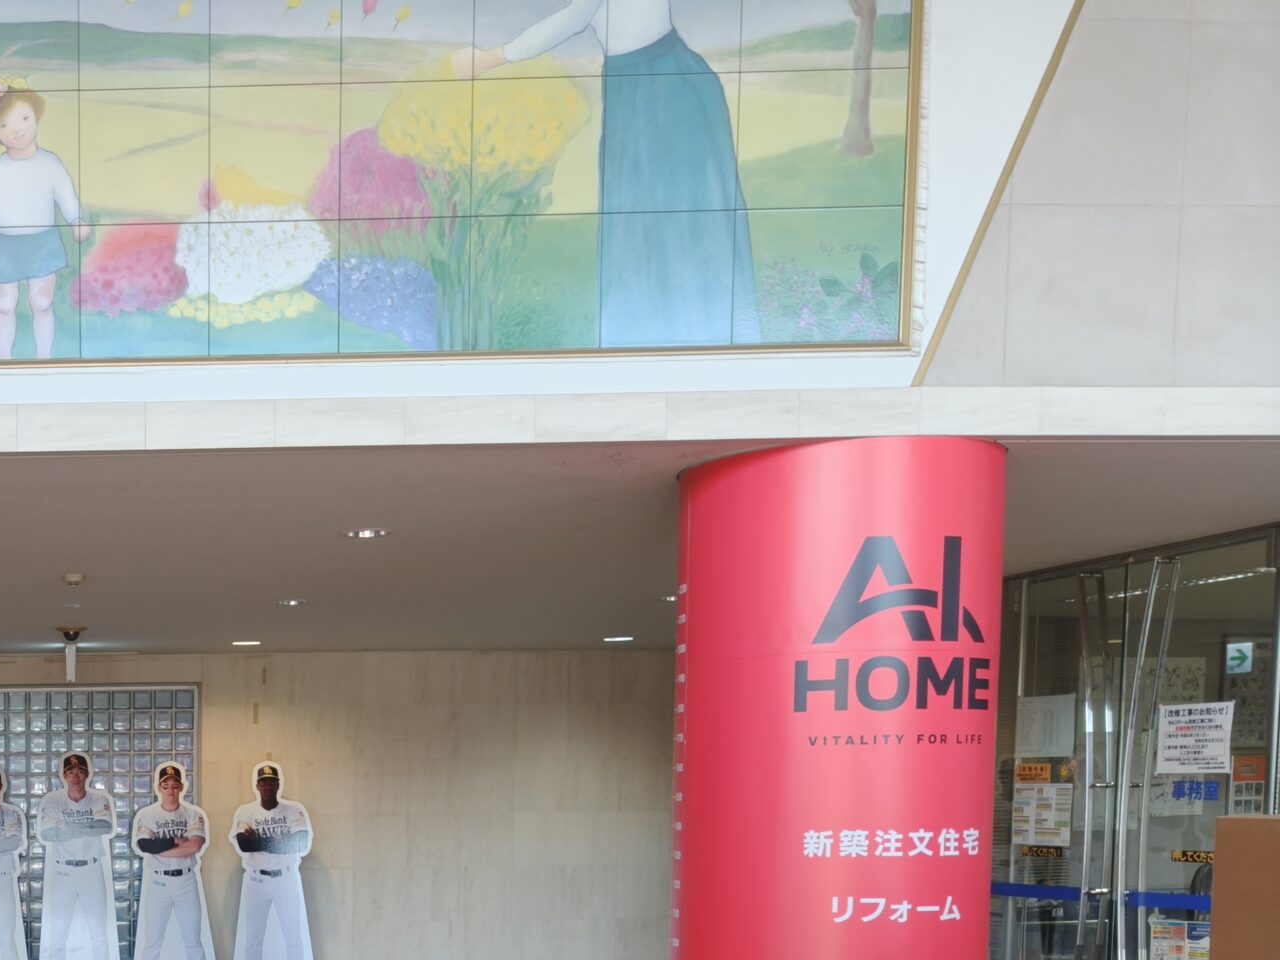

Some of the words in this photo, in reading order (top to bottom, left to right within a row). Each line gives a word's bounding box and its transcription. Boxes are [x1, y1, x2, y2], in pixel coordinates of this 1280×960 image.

[793, 656, 990, 712] HOME
[808, 734, 905, 746] VITALITY
[917, 734, 948, 745] FOR
[956, 734, 983, 745] LIFE
[1172, 780, 1220, 801] 事務室
[156, 819, 188, 830] SoftBank
[254, 816, 287, 827] SoftBank
[804, 829, 979, 858] 新築注文住宅
[1172, 849, 1216, 863] 押してくださ
[831, 896, 961, 923] リフォーム
